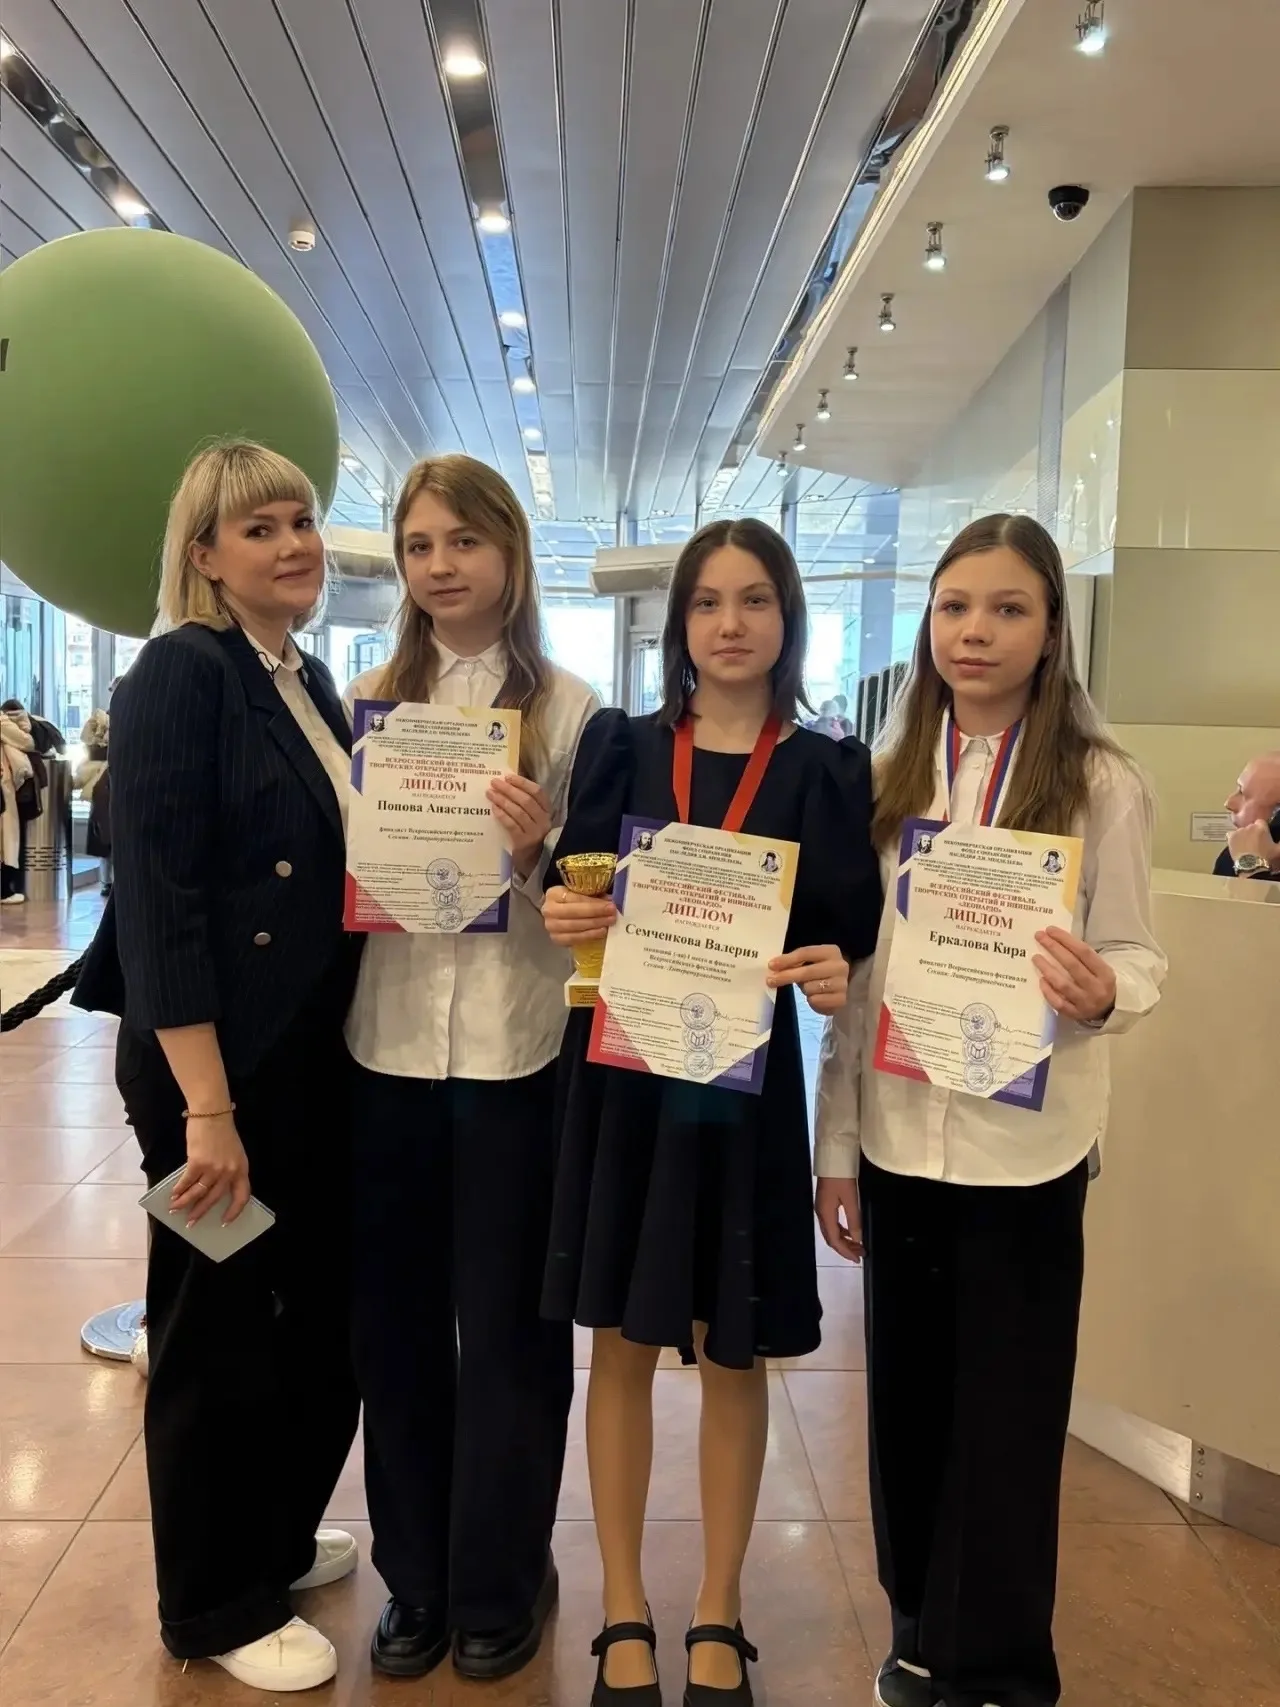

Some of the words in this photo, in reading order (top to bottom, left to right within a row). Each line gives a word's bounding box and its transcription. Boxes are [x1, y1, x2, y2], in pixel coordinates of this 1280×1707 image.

[386, 758, 444, 766] ВСЕРОССИЙСКИЙ
[400, 778, 466, 792] ДИПЛОМ
[378, 800, 423, 813] Попова
[426, 804, 491, 816] Анастасия
[633, 882, 679, 894] ТВОРЧЕСКИХ
[680, 890, 719, 900] ОТКРЫТИЙ
[728, 898, 772, 911] ИНИЦИАТИВ
[650, 879, 712, 892] ВСЕРОССИЙСКИЙ
[713, 889, 755, 901] ФЕСТИВАЛЬ
[915, 887, 957, 899] ТВОРЧЕСКИХ
[960, 894, 998, 906] ОТКРЫТИЙ
[1007, 902, 1053, 914] ИНИЦИАТИВ
[930, 882, 990, 896] ВСЕРОССИЙСКИЙ
[992, 892, 1036, 904] ФЕСТИВАЛЬ
[662, 902, 733, 924] ДИПЛОМ
[944, 908, 1014, 930] ДИПЛОМ
[625, 923, 701, 947] Семченкова
[705, 938, 759, 959] Валерия
[930, 930, 989, 952] Еркалова
[993, 941, 1027, 959] Кира
